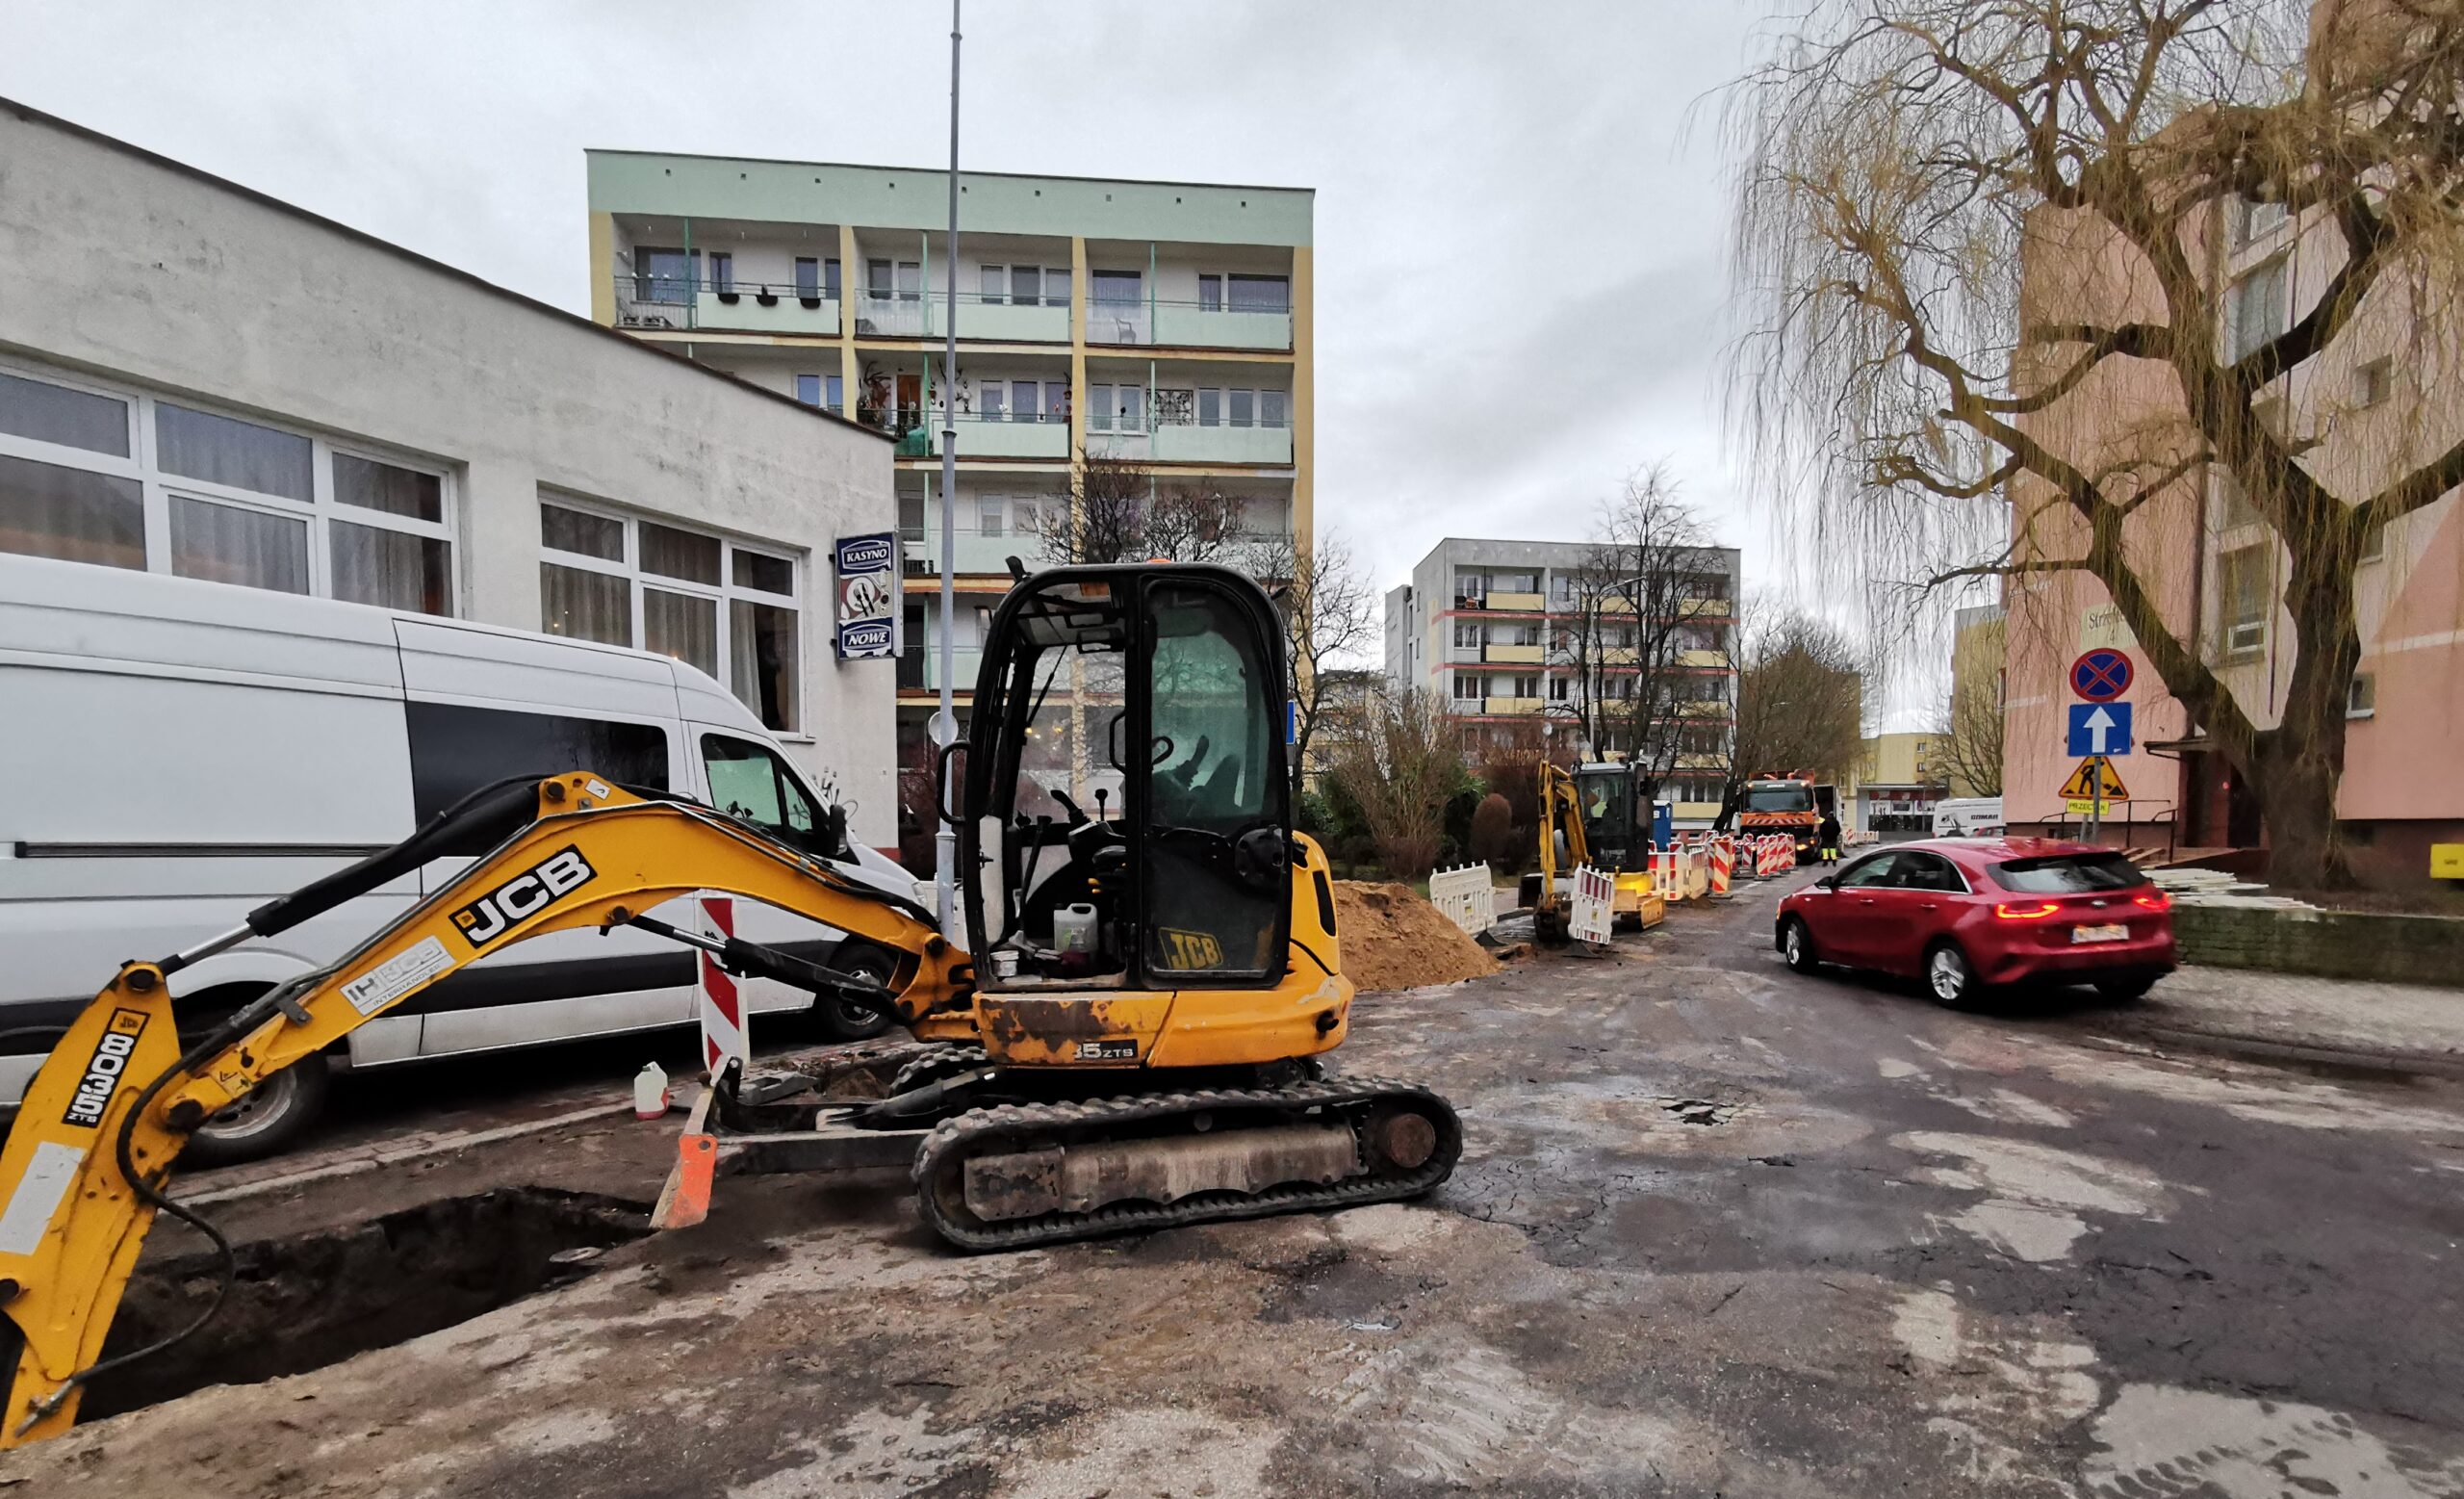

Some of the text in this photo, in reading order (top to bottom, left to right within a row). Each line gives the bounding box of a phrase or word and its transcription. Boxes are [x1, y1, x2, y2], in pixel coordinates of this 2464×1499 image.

[846, 548, 887, 563] KASYNO
[848, 632, 887, 646] NOWE
[2068, 802, 2106, 811] PRZECK
[468, 851, 590, 942] JCB
[1169, 933, 1219, 970] JCB
[72, 1033, 135, 1116] 8035
[66, 1112, 98, 1124] ZTS
